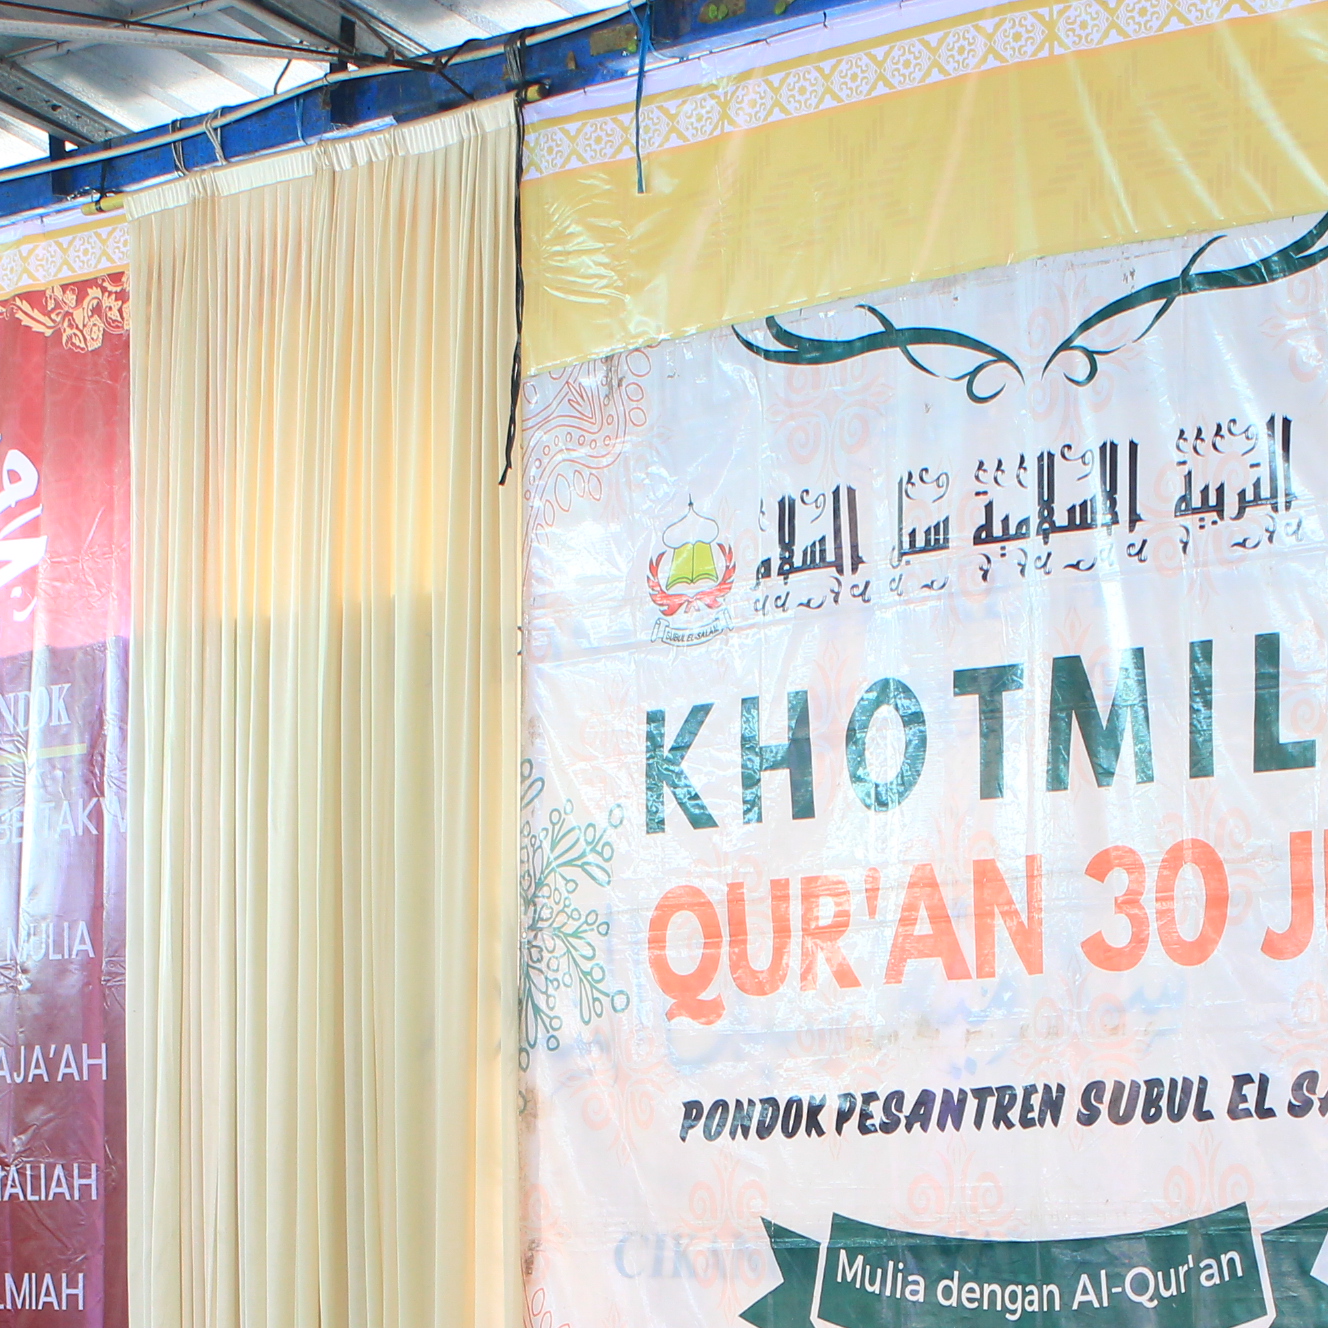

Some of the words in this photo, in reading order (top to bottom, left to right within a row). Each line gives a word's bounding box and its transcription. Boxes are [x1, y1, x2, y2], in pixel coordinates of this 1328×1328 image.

[643, 632, 1318, 835] KHOTMIL
[6, 920, 96, 966] MULIA
[646, 853, 1043, 1024] QUR'AN
[1080, 836, 1231, 975] 30
[679, 1093, 827, 1143] PONDOK
[835, 1081, 1066, 1138] PESANTREN
[1075, 1074, 1215, 1127] SUBUL
[1226, 1072, 1277, 1121] EL
[836, 1248, 926, 1303] Mulia
[936, 1270, 1061, 1321] dengan
[1072, 1249, 1243, 1311] Al-Qur'an
